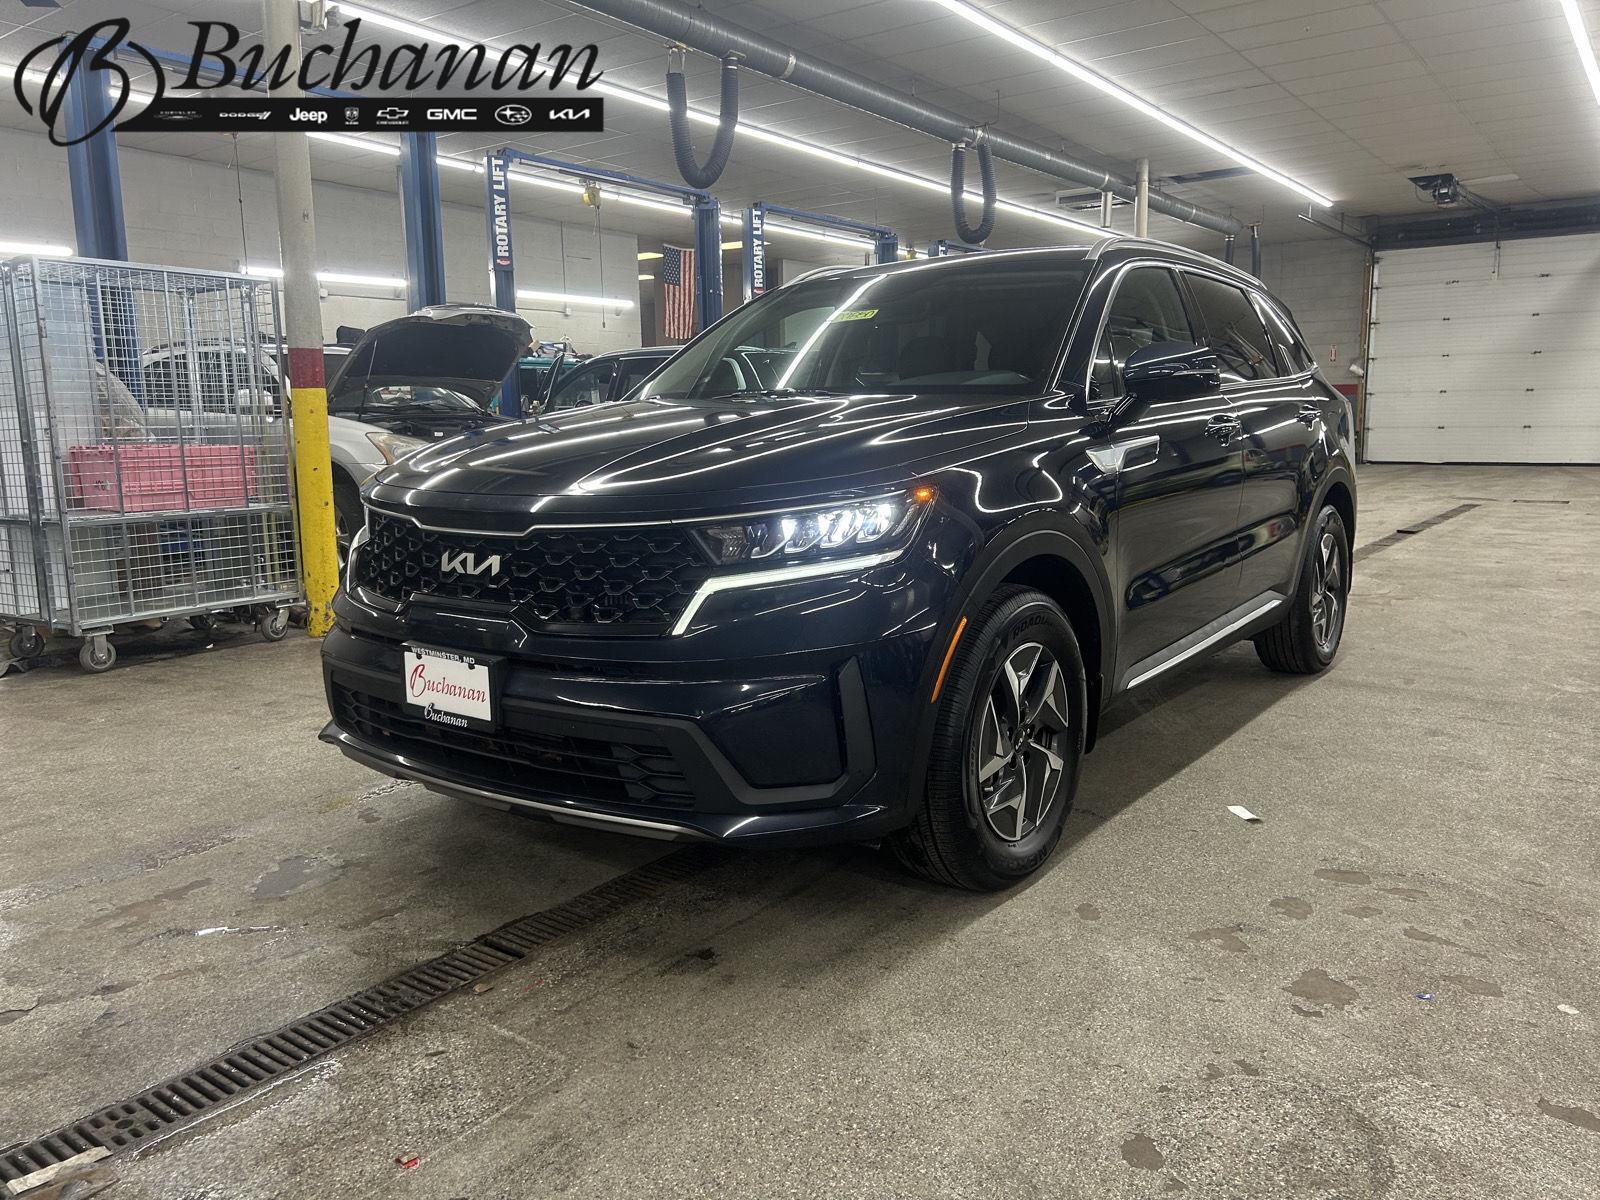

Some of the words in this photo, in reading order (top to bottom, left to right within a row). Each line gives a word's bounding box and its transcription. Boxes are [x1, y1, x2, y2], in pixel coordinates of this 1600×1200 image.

[492, 157, 504, 191] LIFT
[494, 193, 510, 257] ROTARY
[752, 209, 762, 235] LIFT
[753, 237, 763, 287] ROTARY
[441, 551, 501, 577] KIA
[463, 656, 475, 664] MD
[410, 664, 486, 702] Buchanan
[424, 703, 468, 727] Buchanan
